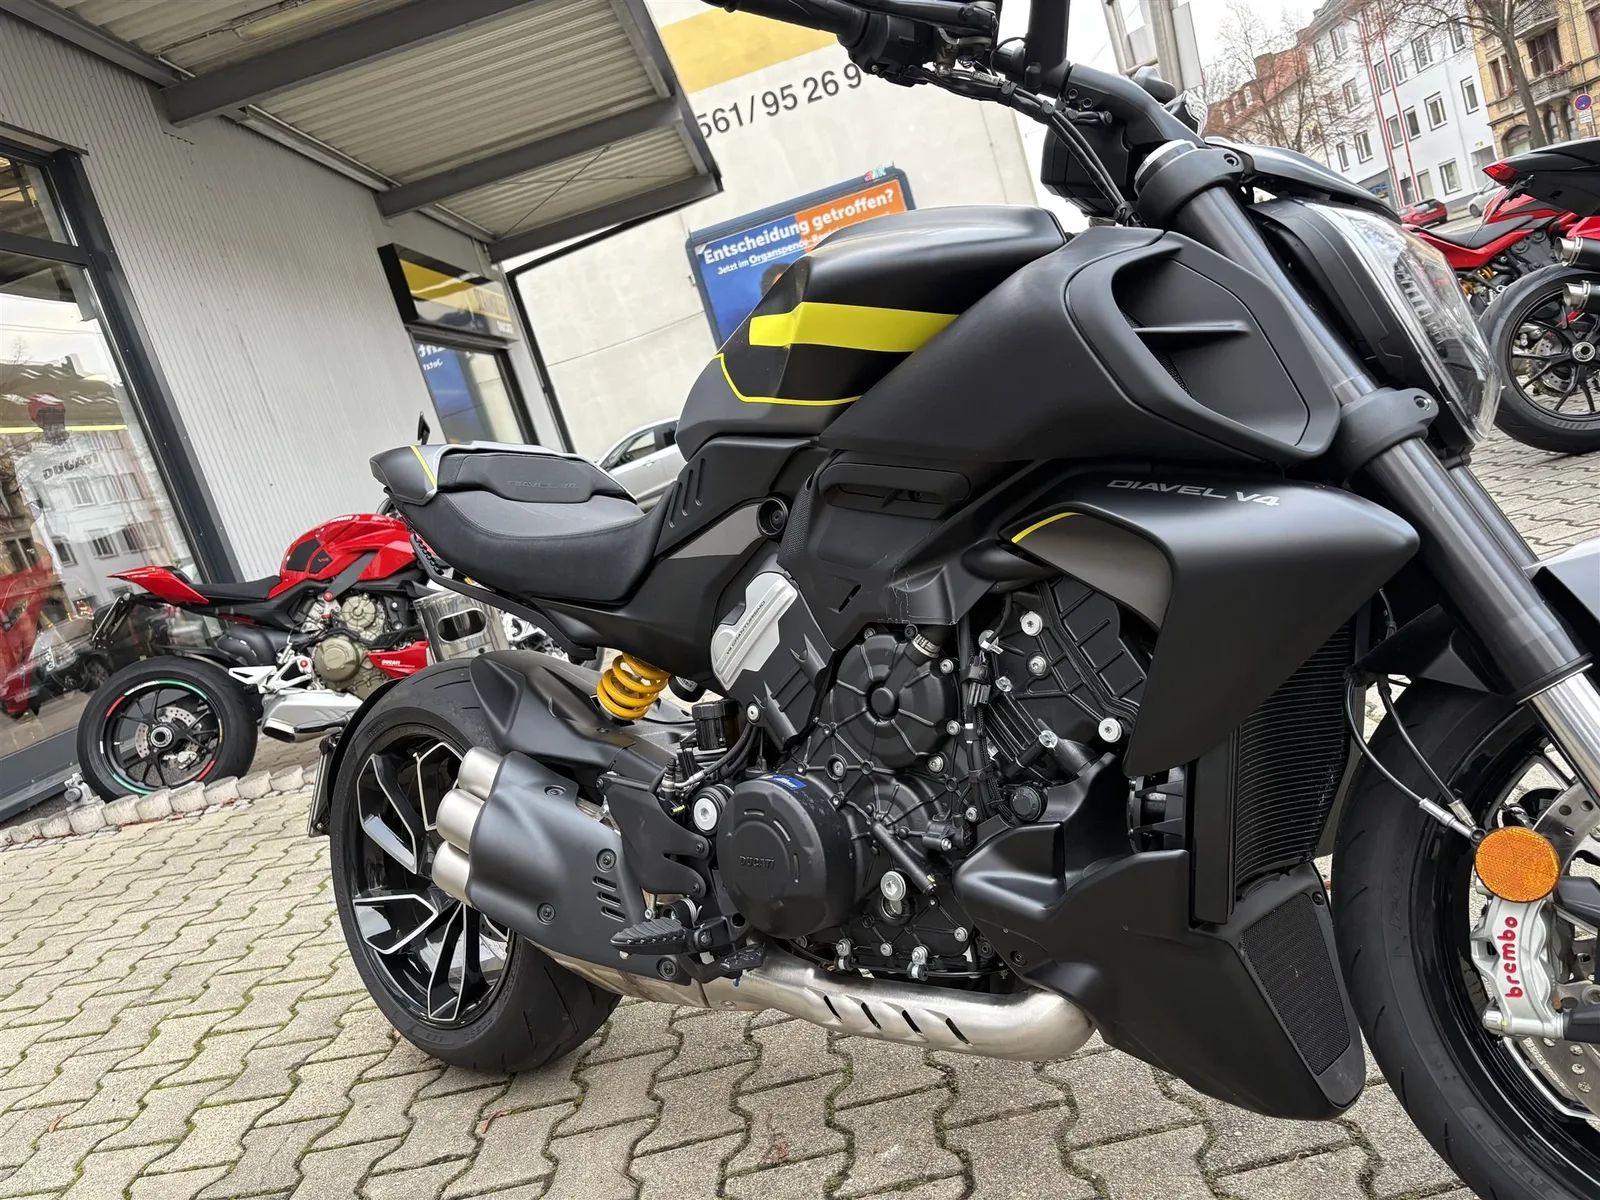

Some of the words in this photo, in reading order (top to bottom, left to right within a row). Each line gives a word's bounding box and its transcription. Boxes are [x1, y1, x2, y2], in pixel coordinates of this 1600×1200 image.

[803, 70, 839, 104] 26
[703, 219, 810, 264] Entscheidung
[812, 188, 894, 230] getroffen?
[717, 262, 738, 275] Jetzt
[738, 259, 750, 268] im
[42, 452, 99, 480] DUCATI
[1107, 479, 1227, 499] DIAVEL
[1236, 491, 1280, 507] V4
[739, 855, 775, 871] DUCATI
[1497, 916, 1523, 998] brembo
